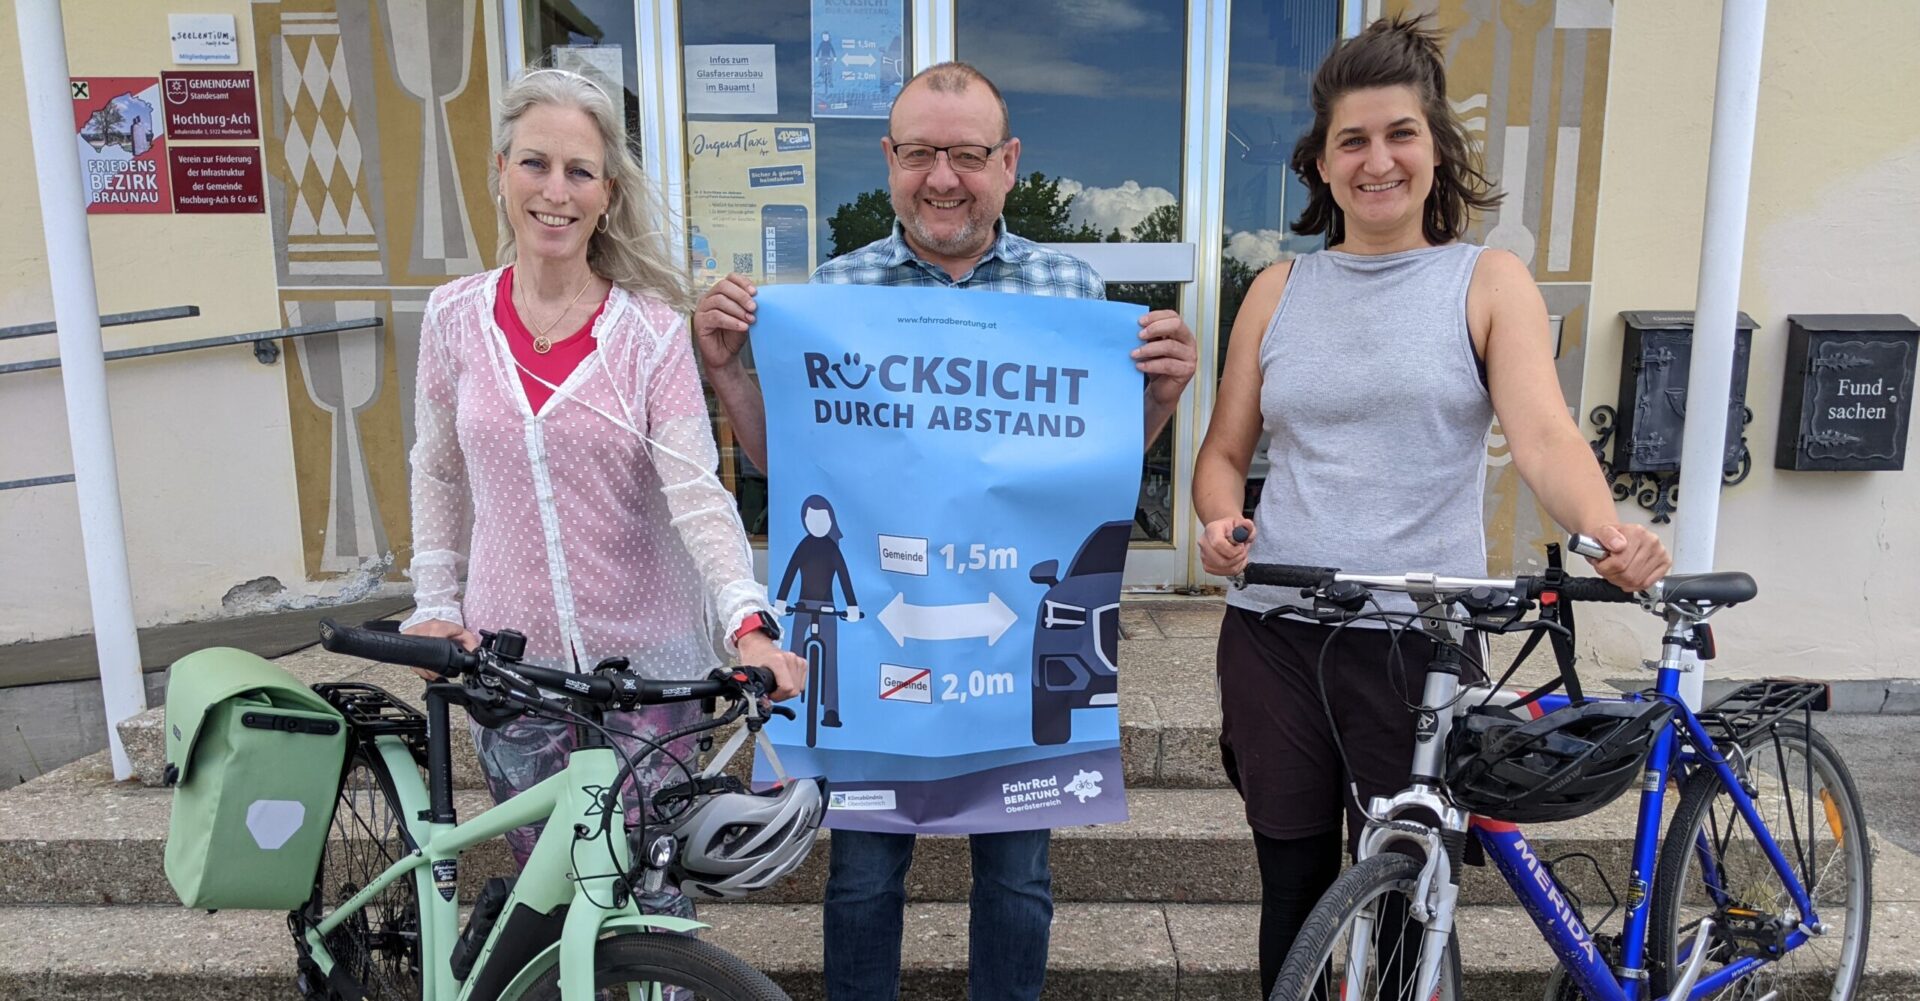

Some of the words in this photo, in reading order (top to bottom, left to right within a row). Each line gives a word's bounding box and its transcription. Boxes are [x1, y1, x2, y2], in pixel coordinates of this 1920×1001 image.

[709, 56, 730, 64] Infos
[697, 70, 763, 79] Glasfaserausbau
[189, 79, 250, 89] GEMEINDEAMT
[706, 84, 716, 92] im
[718, 83, 750, 92] Bauamt
[190, 92, 229, 100] Standesamt
[172, 113, 251, 127] Hochburg-Ach
[88, 160, 156, 172] FRIEDENS
[178, 155, 201, 163] Verein
[215, 155, 252, 164] Förderung
[187, 168, 199, 176] der
[201, 168, 245, 176] Infrastruktur
[90, 174, 158, 190] BEZIRK
[192, 182, 204, 190] der
[206, 182, 243, 190] Gemeinde
[92, 192, 158, 203] BRAUNAU
[180, 196, 229, 205] Hochburg-Ach
[237, 195, 247, 203] Co
[897, 316, 997, 329] www.fahrradberatung.at
[804, 352, 1089, 405] RÜCKSICHT
[1828, 403, 1887, 420] sachen
[814, 399, 914, 429] DURCH
[927, 405, 1086, 439] ABSTAND
[882, 548, 924, 562] Gemeinde
[939, 543, 1018, 574] 1,5m
[884, 677, 928, 691] Gemeinde
[941, 670, 1014, 704] 2,0m
[1002, 776, 1057, 793] FahrRad
[1004, 789, 1060, 805] BERATUNG
[1006, 800, 1061, 813] Oberösterreich
[1514, 839, 1594, 963] MERIDA
